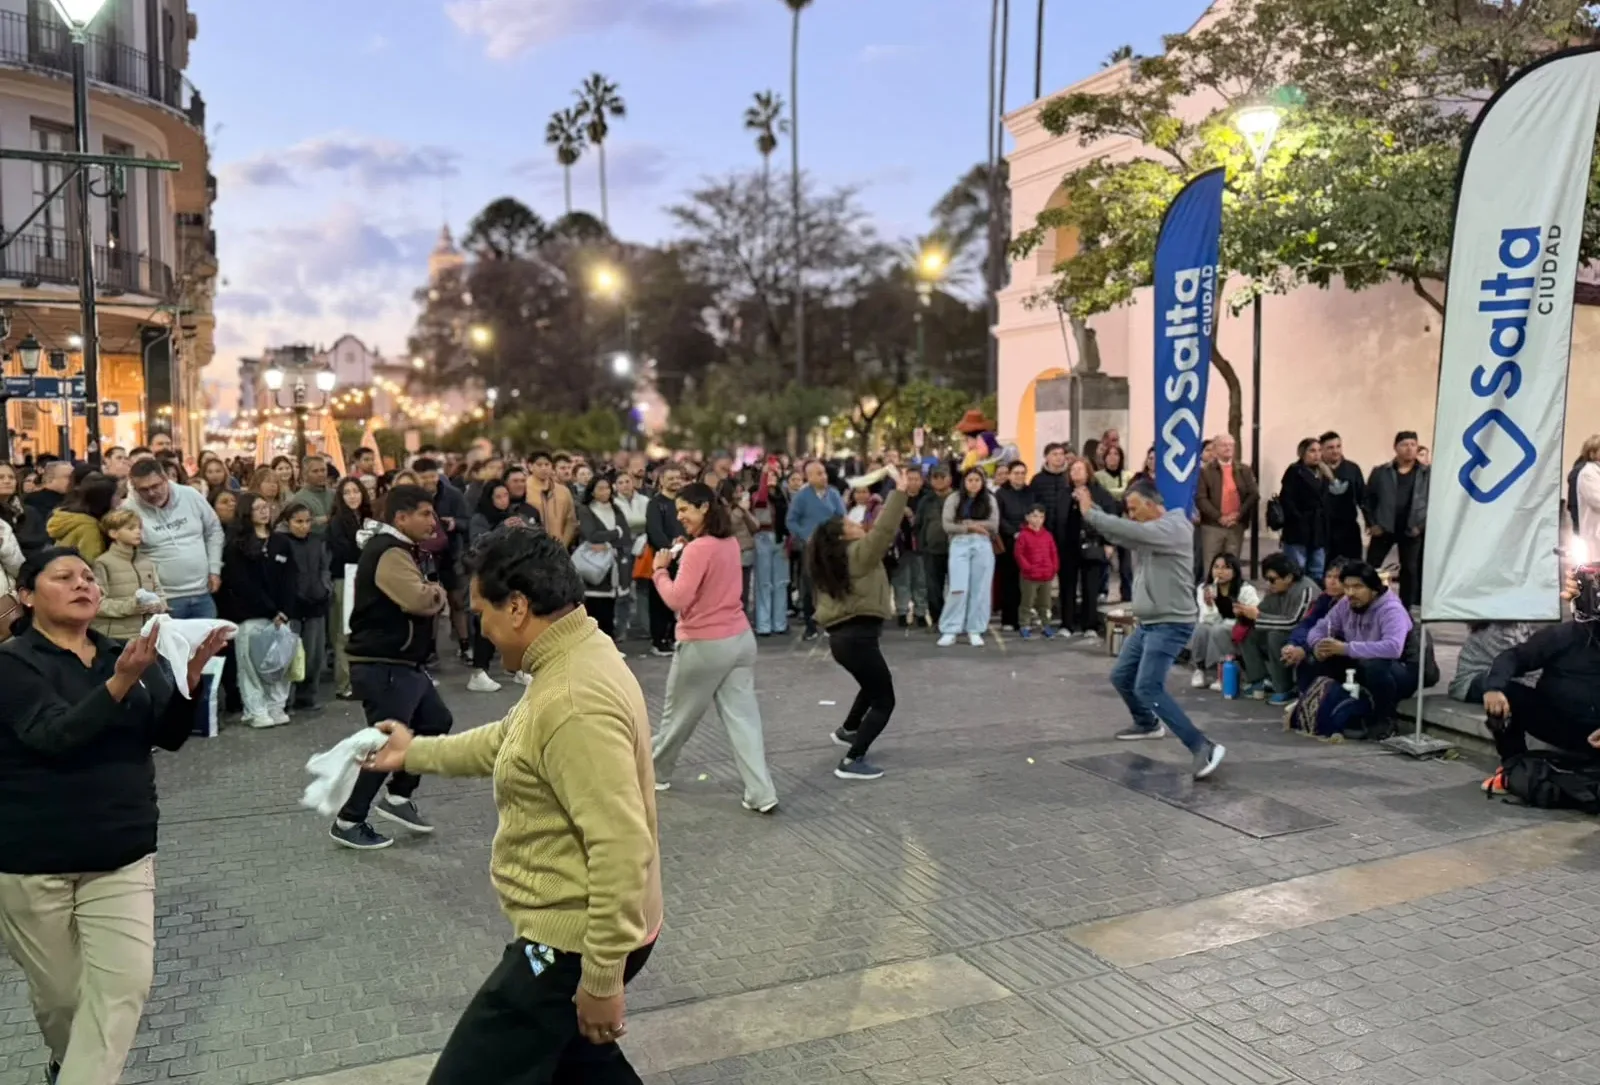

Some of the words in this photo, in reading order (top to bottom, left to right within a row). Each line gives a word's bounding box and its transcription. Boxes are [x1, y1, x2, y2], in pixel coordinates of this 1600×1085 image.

[1203, 264, 1214, 336] CIUDAD
[1471, 227, 1541, 399] Salta
[1537, 224, 1561, 315] CIUDAD
[1165, 267, 1201, 402] Salta
